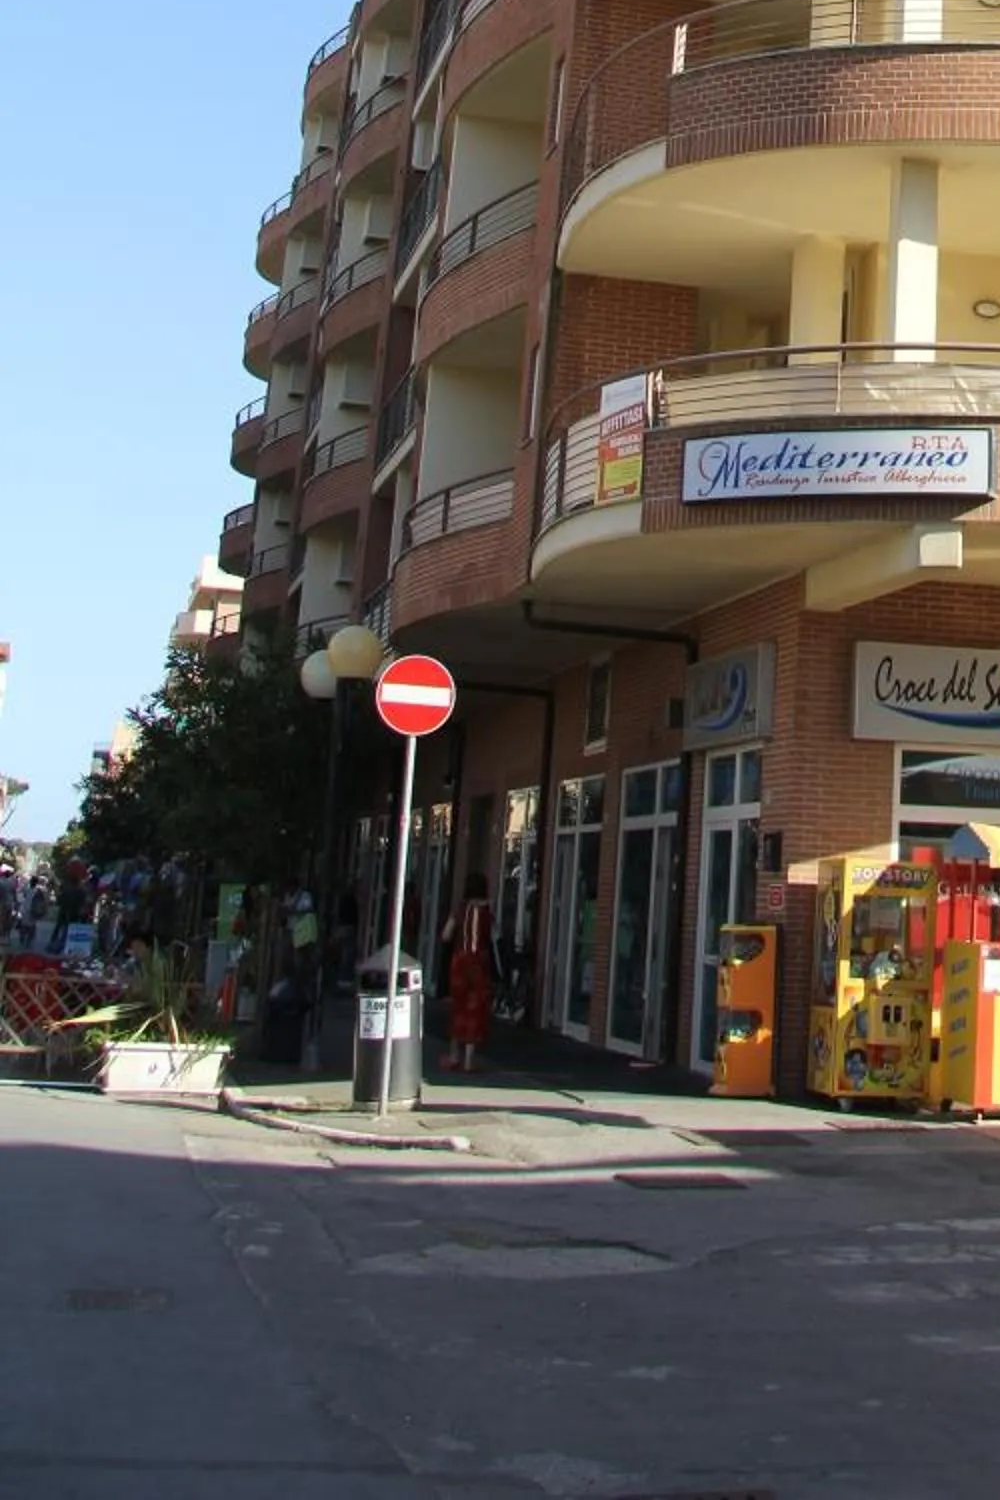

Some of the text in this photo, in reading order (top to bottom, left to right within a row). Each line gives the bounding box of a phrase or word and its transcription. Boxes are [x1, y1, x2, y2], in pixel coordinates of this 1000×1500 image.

[698, 437, 968, 497] Mediterraneo
[875, 655, 938, 704] Croce
[943, 657, 978, 704] del
[852, 868, 929, 881] TOY STORY
